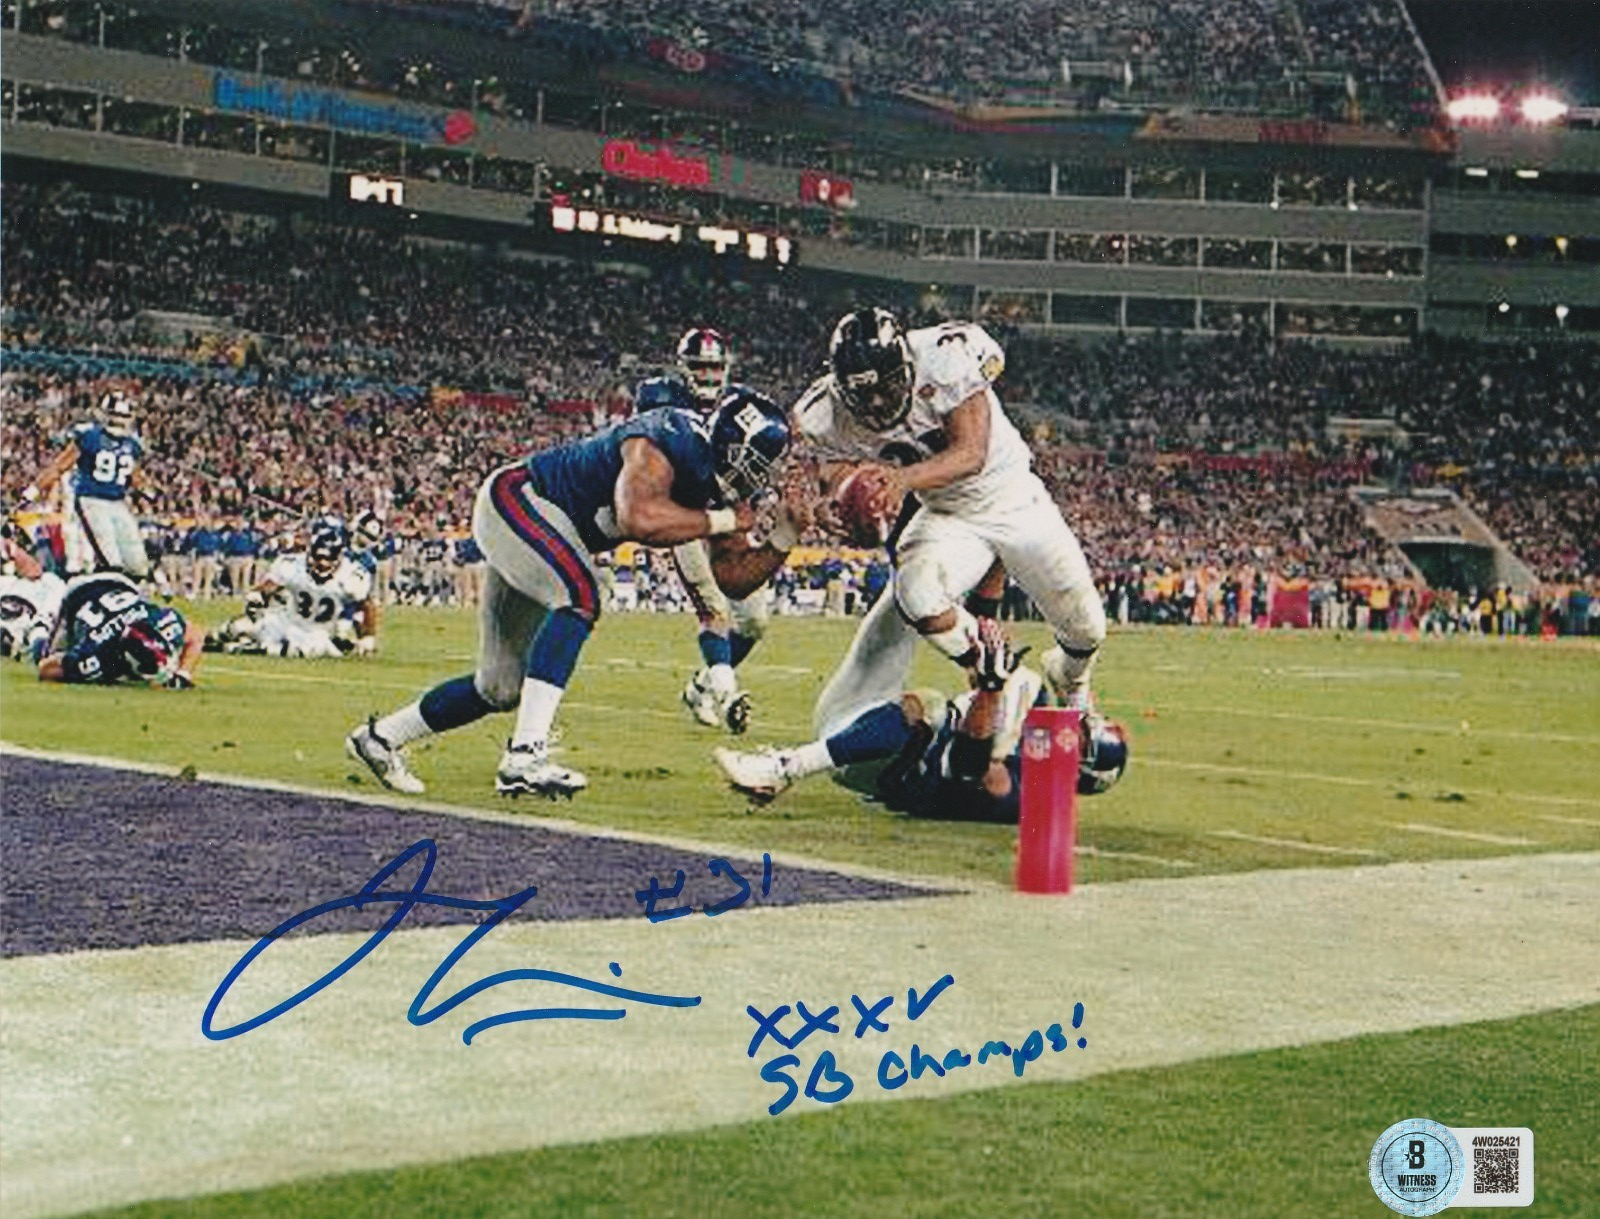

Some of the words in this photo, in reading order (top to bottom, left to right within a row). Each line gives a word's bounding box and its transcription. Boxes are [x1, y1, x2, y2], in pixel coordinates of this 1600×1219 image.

[93, 449, 135, 486] 92
[297, 590, 335, 623] 32
[747, 974, 954, 1058] XXXV
[760, 1050, 854, 1116] SB
[1472, 1135, 1521, 1147] 4W025421
[1397, 1174, 1437, 1187] WITNESS
